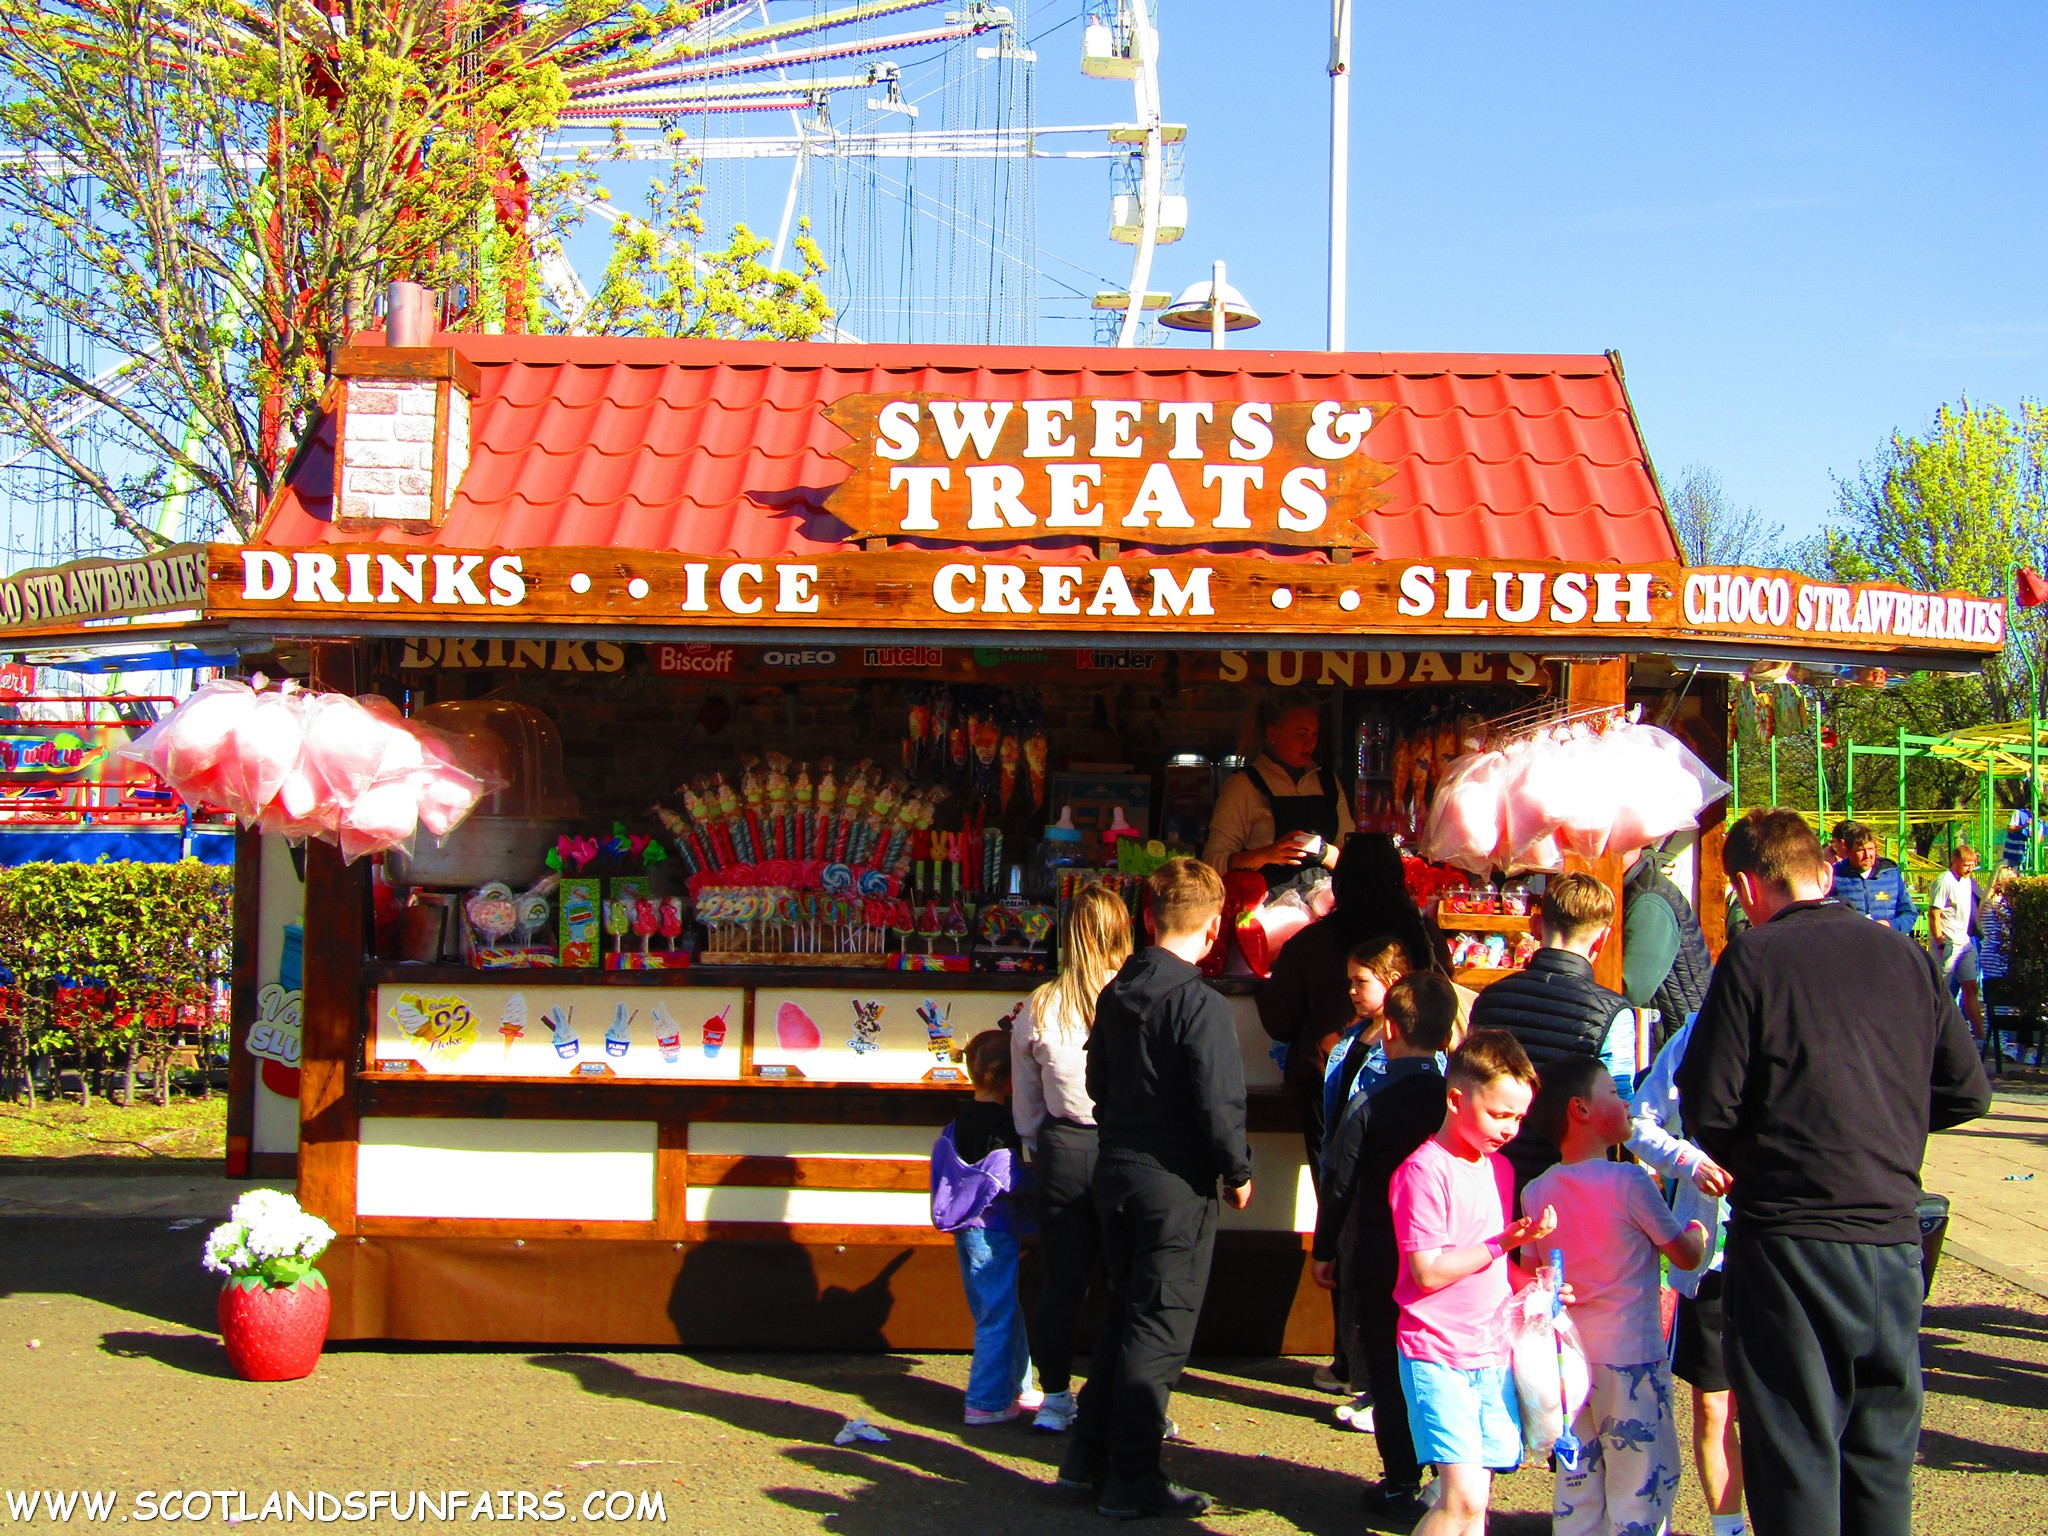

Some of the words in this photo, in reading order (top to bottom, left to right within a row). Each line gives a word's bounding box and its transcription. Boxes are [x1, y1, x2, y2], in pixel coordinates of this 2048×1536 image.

[874, 400, 1275, 461] SWEETS
[1305, 400, 1374, 461] &
[889, 463, 1329, 533] TREATS
[24, 552, 206, 622] STRAWBERRIES
[240, 550, 527, 607] DRINKS
[681, 563, 820, 615] ICE
[932, 563, 1216, 618] CREAM
[1397, 565, 1654, 625] SLUSH
[1682, 572, 1790, 628] CHOCO
[1795, 583, 2003, 646] STRAWBERRIES
[400, 637, 625, 673] DRINKS
[660, 646, 734, 672] Biscoff
[763, 650, 837, 666] OREO
[863, 647, 943, 667] nutella
[1076, 648, 1156, 670] Kinder
[1219, 650, 1537, 687] SUNDAES
[434, 1004, 471, 1040] 99
[251, 1025, 301, 1062] SLU
